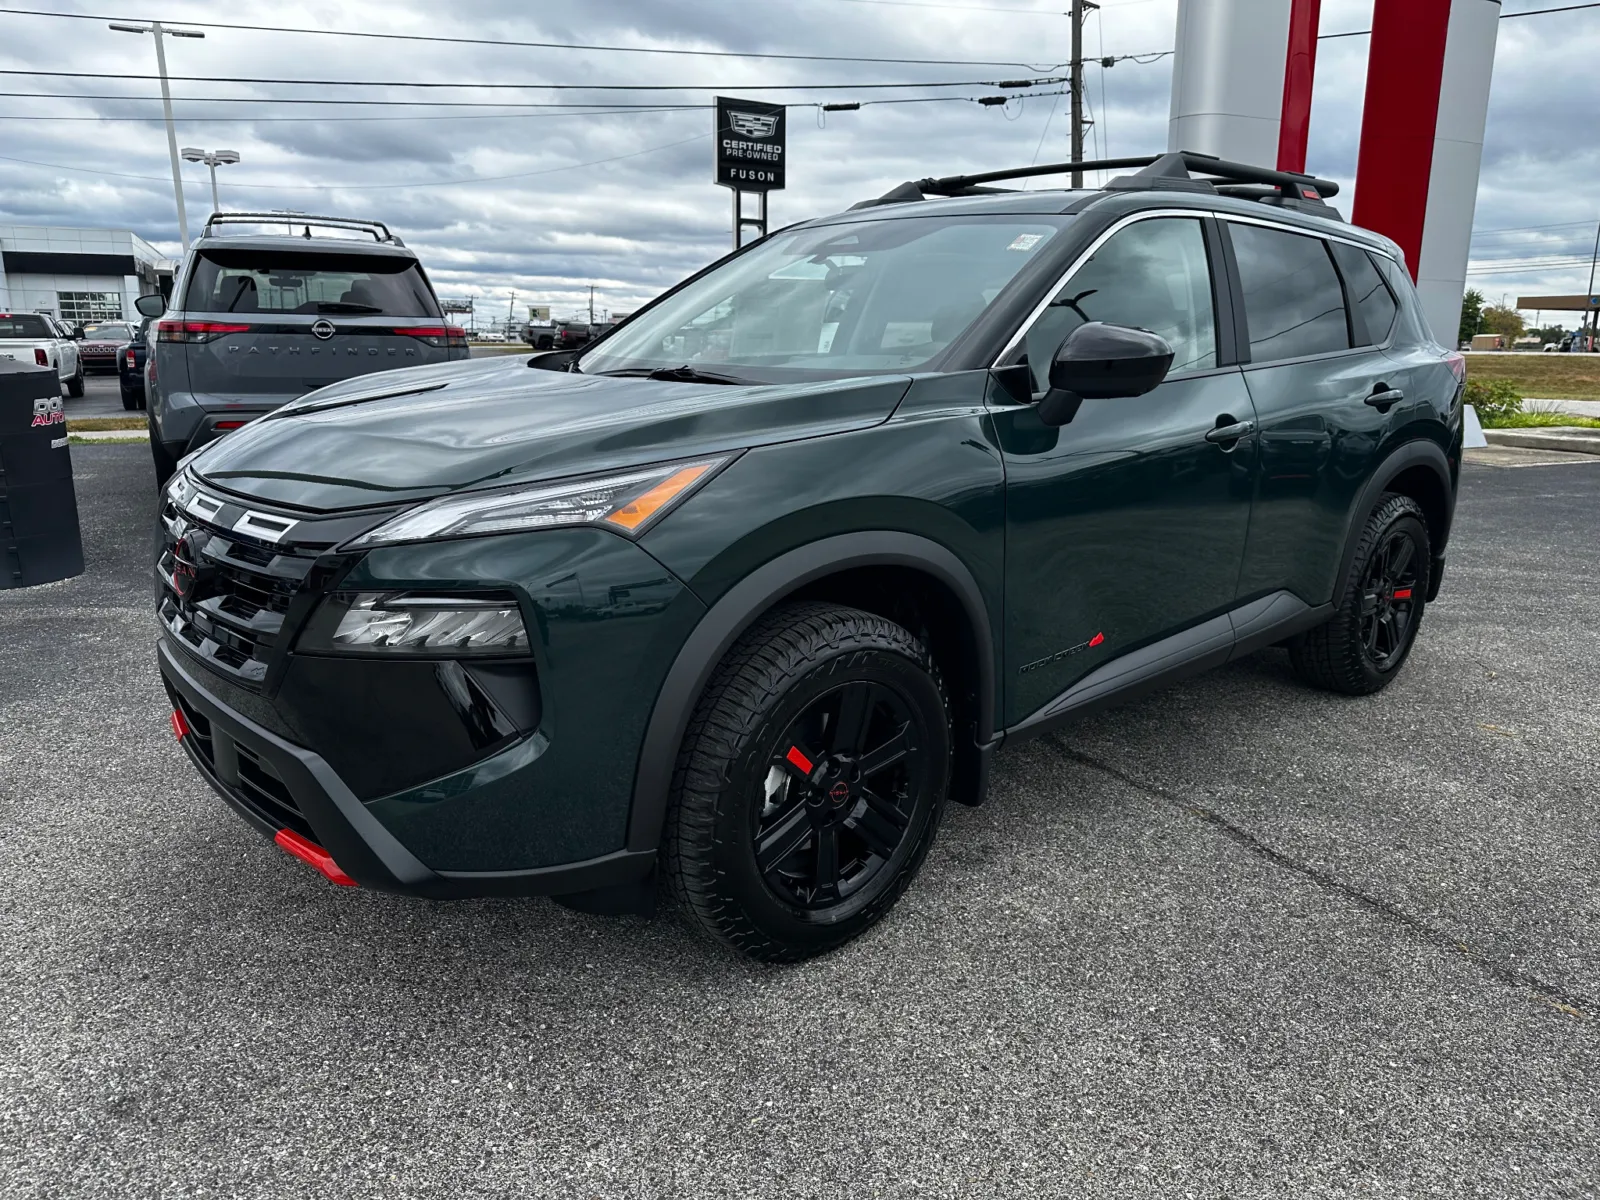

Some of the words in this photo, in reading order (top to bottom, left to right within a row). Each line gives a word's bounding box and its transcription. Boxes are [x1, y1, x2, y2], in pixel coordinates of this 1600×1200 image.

[723, 140, 781, 153] CERTIFIED
[726, 149, 778, 160] PRE-OWNED
[730, 169, 774, 181] FUSON
[229, 346, 415, 356] PATHFINDER
[33, 396, 62, 415] DO
